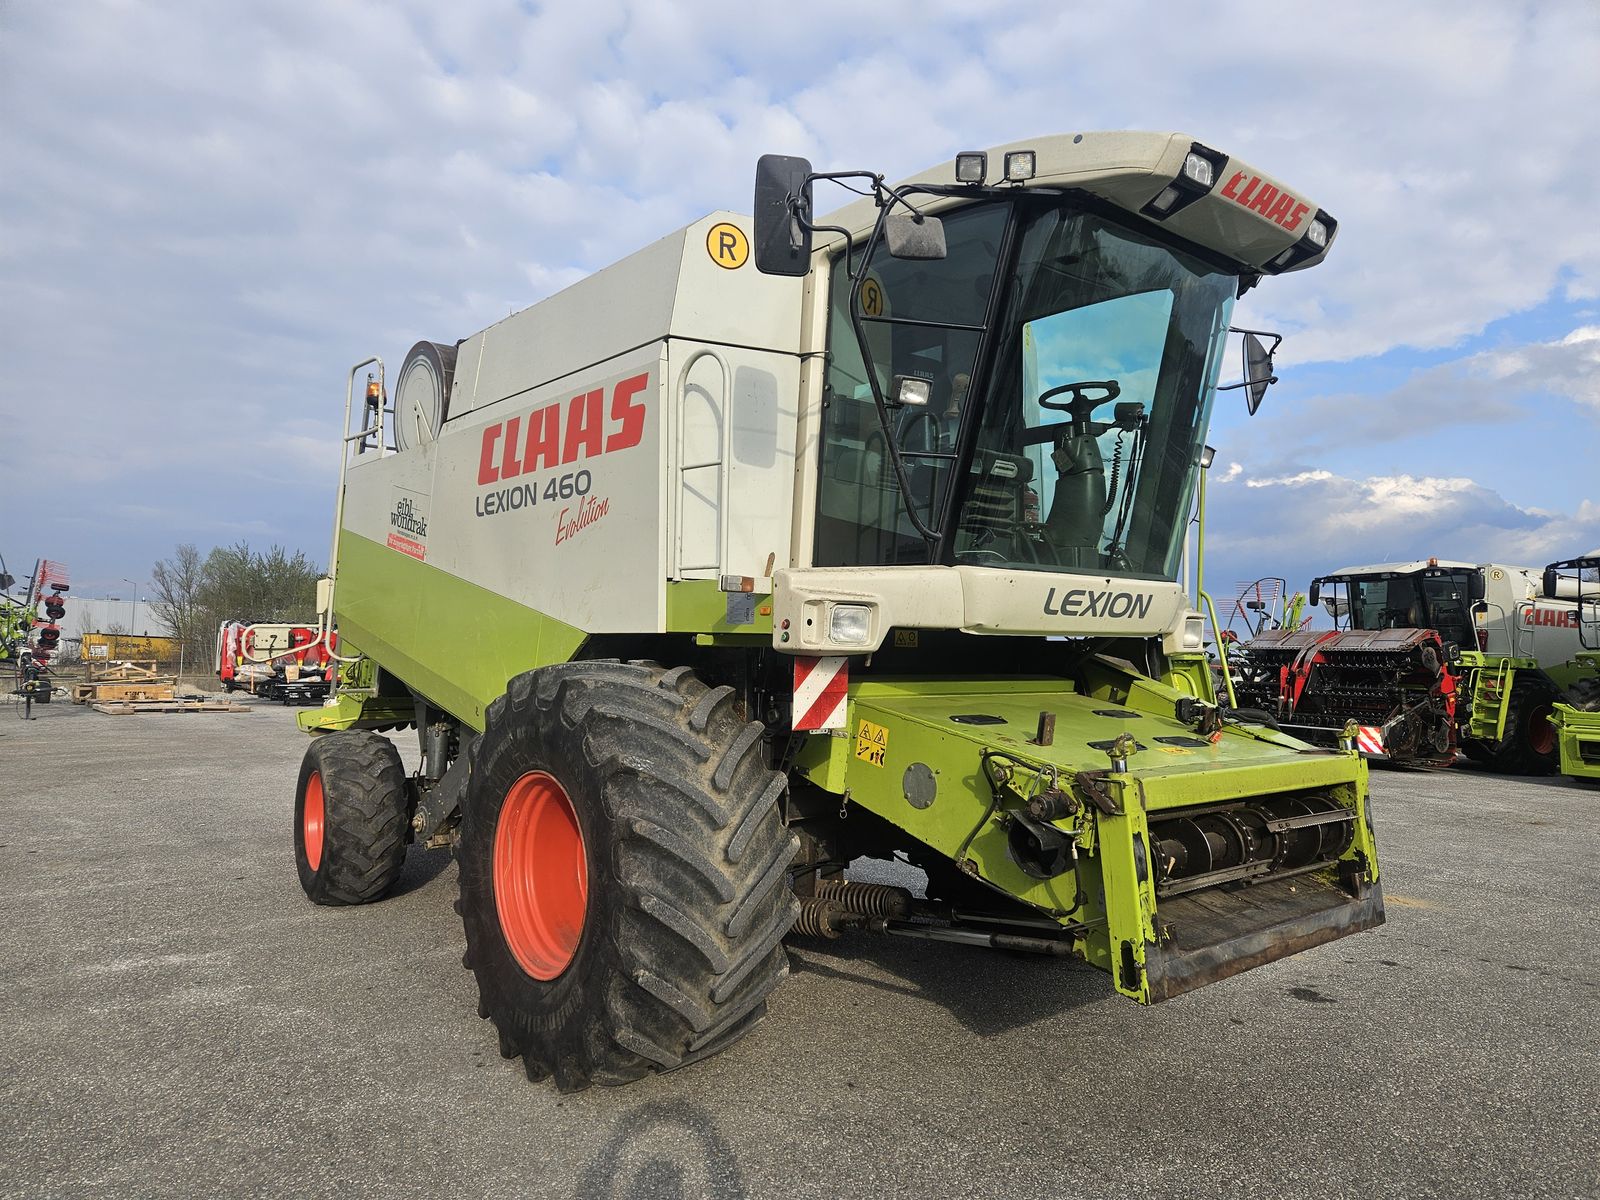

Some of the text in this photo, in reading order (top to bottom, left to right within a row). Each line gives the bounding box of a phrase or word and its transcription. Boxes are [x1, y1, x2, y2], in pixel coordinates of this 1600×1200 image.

[1220, 170, 1310, 231] CLAAS
[719, 231, 737, 262] R
[477, 372, 649, 486] CLAAS
[475, 469, 592, 517] LEXION 460
[555, 494, 610, 546] Evolution
[1043, 587, 1153, 619] LEXION
